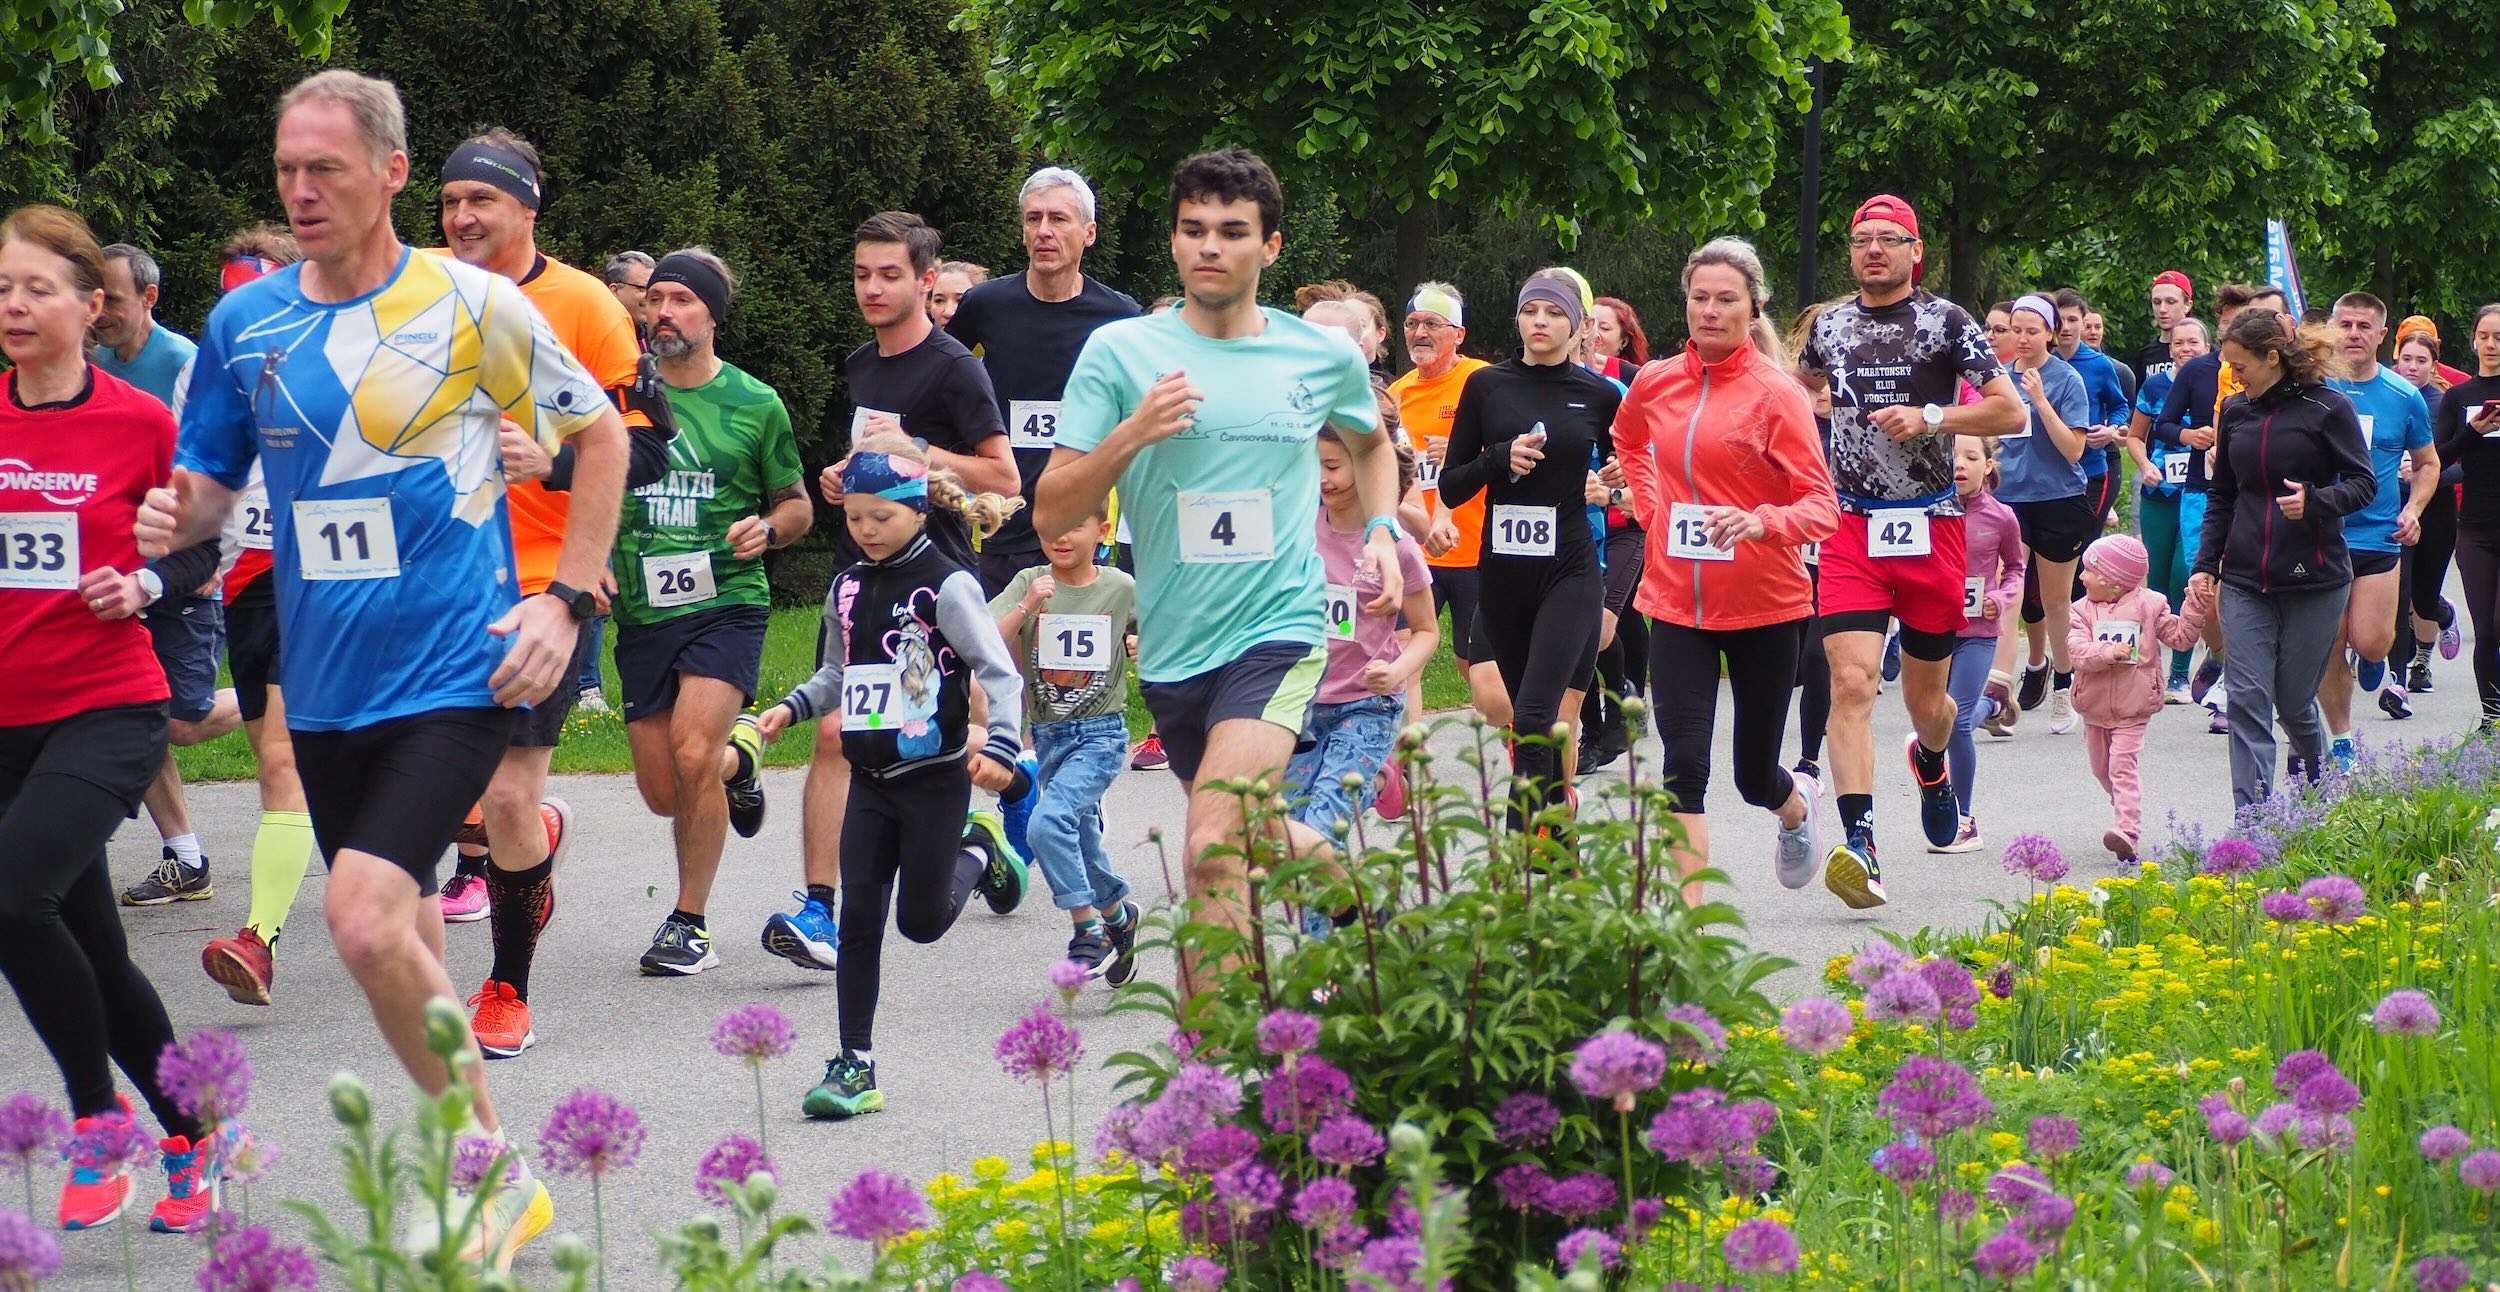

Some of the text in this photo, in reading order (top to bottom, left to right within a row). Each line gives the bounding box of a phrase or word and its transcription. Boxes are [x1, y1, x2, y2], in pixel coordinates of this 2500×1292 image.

[1856, 364, 1912, 377] MARATONSKÝ
[1864, 391, 1911, 404] PROSTĚJOV
[1875, 380, 1896, 390] KLUB
[1023, 414, 1056, 438] 43
[245, 507, 273, 536] 25
[646, 496, 698, 527] TRAIL
[320, 521, 370, 561] 11
[1210, 511, 1236, 546] 4
[1500, 518, 1550, 545] 108
[1675, 519, 1714, 547] 13
[1880, 521, 1913, 545] 42
[657, 567, 696, 595] 26
[1056, 630, 1095, 658] 15
[844, 683, 891, 715] 127
